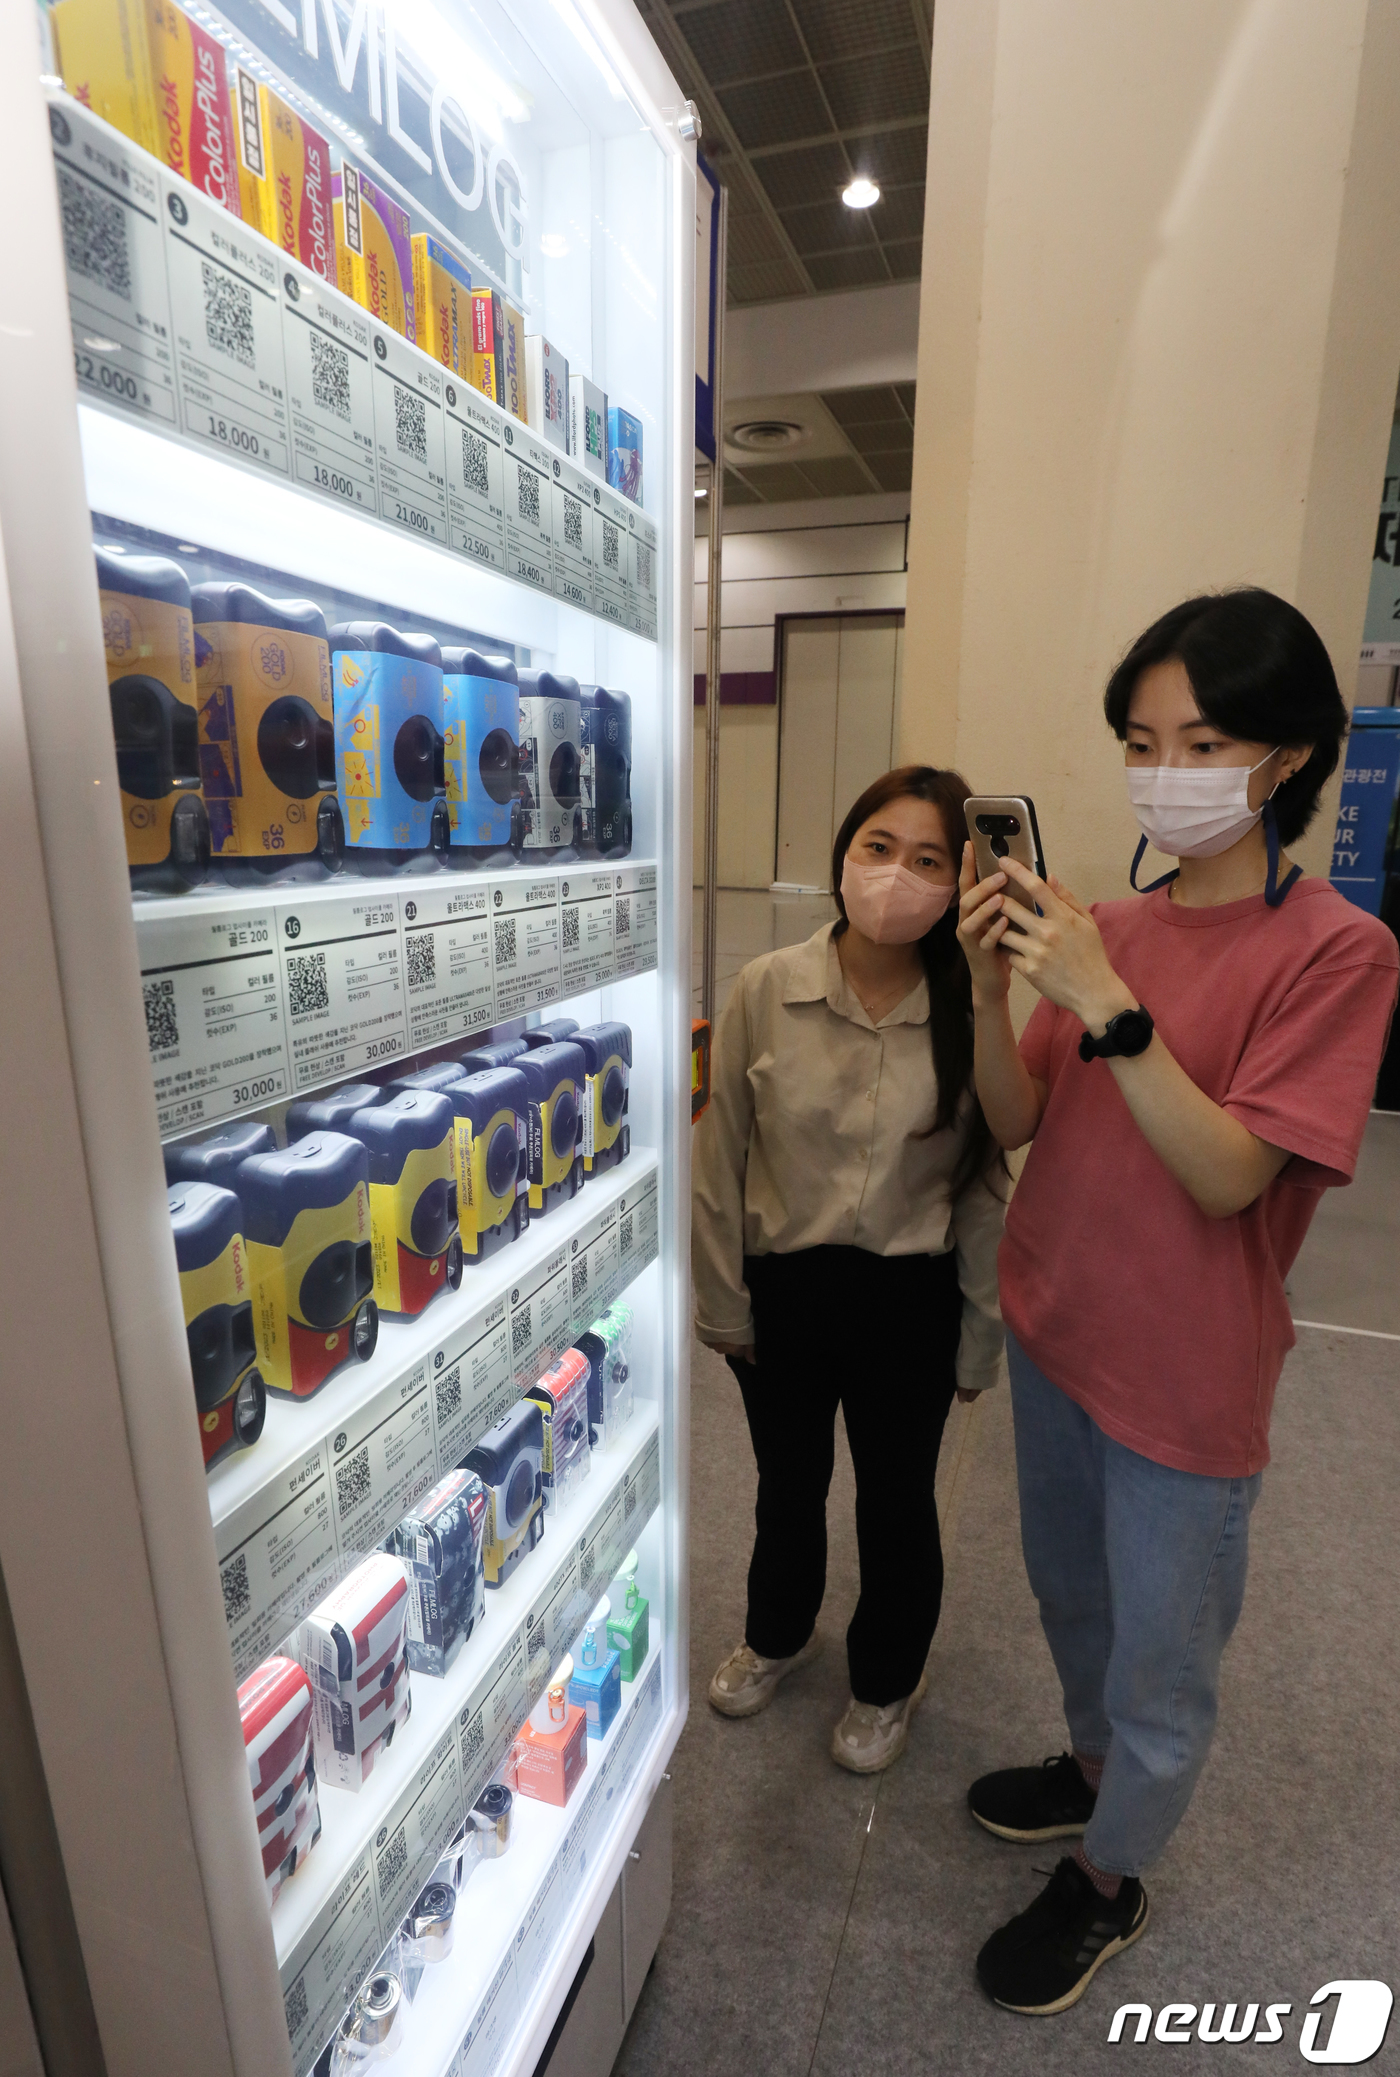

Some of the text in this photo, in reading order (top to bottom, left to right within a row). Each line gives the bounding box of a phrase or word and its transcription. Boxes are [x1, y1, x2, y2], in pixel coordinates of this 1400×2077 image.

[197, 46, 228, 206] ColorPlus
[277, 172, 297, 258] Kodak
[305, 146, 328, 280] ColorPlus
[367, 250, 380, 318] Kodak
[354, 328, 367, 348] 200
[440, 304, 451, 368] Kodak
[429, 380, 440, 396] 200
[207, 414, 260, 459] 18,000
[312, 463, 353, 500] 18,000
[395, 502, 428, 534] 21,000
[462, 533, 489, 561] 22,500
[563, 581, 582, 602] 14,600
[602, 600, 618, 618] 12,400
[260, 647, 270, 674] 200
[269, 642, 281, 682] GOLD
[1343, 767, 1387, 784] 관광전
[262, 830, 270, 851] EXP
[270, 823, 285, 850] 36
[399, 822, 410, 845] 36
[484, 823, 492, 842] 36
[553, 825, 561, 843] 36
[605, 823, 613, 840] 36
[494, 893, 502, 904] 22
[547, 888, 555, 898] 400
[406, 904, 415, 917] 21
[474, 899, 485, 909] 400
[286, 920, 299, 934] 16
[364, 911, 393, 926] 골드 200
[228, 928, 268, 947] 골드 200
[389, 965, 398, 975] 200
[595, 968, 610, 981] 25,000
[392, 982, 399, 990] 36
[537, 986, 555, 1001] 31,500
[263, 992, 276, 1004] 200
[269, 1011, 277, 1022] 36
[291, 1010, 329, 1026] SAMPLE IMAGE
[462, 1008, 486, 1027] 31,500
[365, 1037, 397, 1061] 30,000
[232, 1077, 275, 1106] 30,000
[356, 1188, 365, 1236] Kodak
[231, 1241, 244, 1294] Kodak
[512, 1288, 518, 1303] 32
[485, 1304, 503, 1328] 펀세이버
[549, 1336, 566, 1361] 30,500
[435, 1352, 443, 1367] 31
[400, 1370, 424, 1399] 펀세이버
[421, 1413, 429, 1426] 800
[484, 1396, 505, 1427] 27,600
[424, 1426, 429, 1437] 27
[335, 1433, 345, 1451] 26
[288, 1457, 320, 1493] 펀세이버
[317, 1505, 327, 1520] 800
[322, 1520, 329, 1532] 27
[433, 1818, 455, 1860] 33,000
